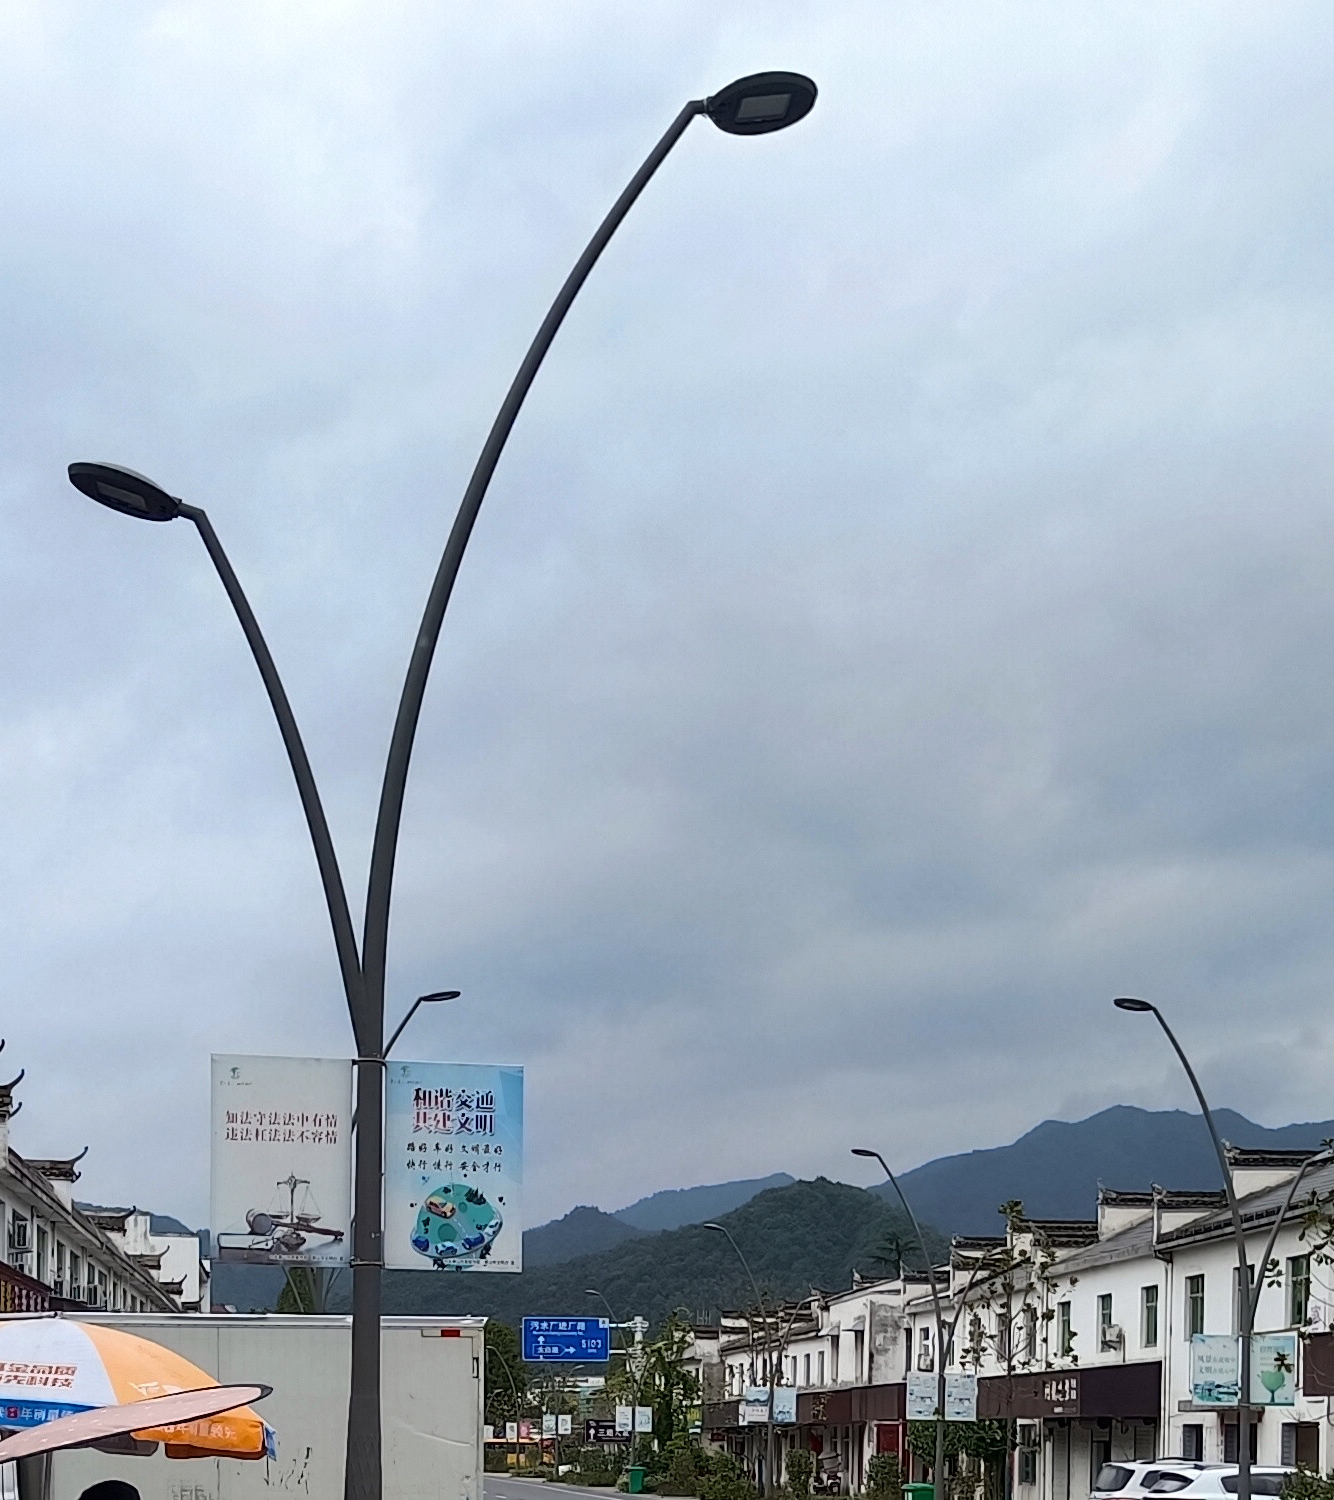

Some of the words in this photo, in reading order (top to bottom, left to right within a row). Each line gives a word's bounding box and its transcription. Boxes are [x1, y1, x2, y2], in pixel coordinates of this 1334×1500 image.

[412, 1087, 495, 1113] 和谐交通
[226, 1110, 338, 1128] 知法守法法中有情
[412, 1111, 495, 1136] 共建文明
